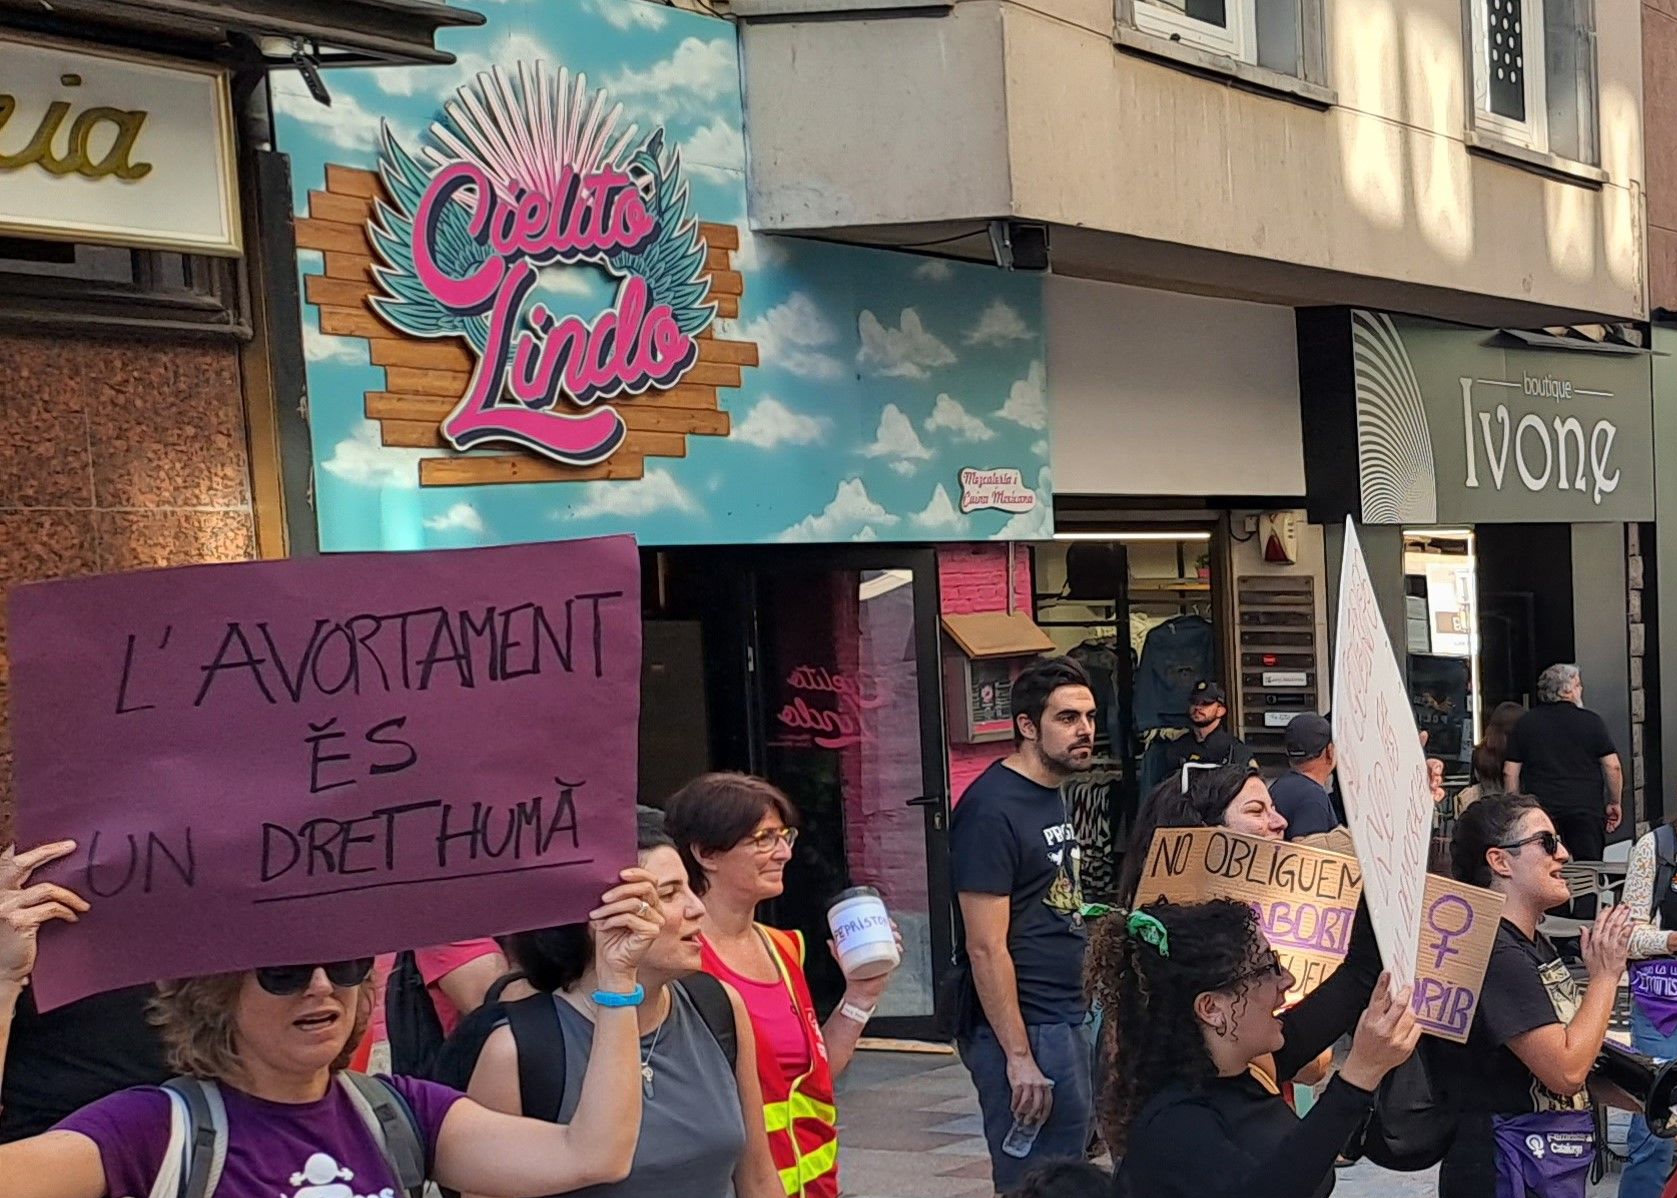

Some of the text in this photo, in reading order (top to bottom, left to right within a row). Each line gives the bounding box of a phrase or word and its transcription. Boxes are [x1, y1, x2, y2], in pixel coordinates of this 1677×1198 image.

[412, 162, 656, 310] Cielito
[447, 260, 692, 460] Lindo
[1522, 370, 1573, 399] boutique
[1459, 376, 1621, 505] Ivone
[115, 591, 624, 714] L'AVORTAMENT
[86, 826, 196, 899] UN
[260, 799, 443, 883] DRET
[1151, 832, 1194, 878] NO
